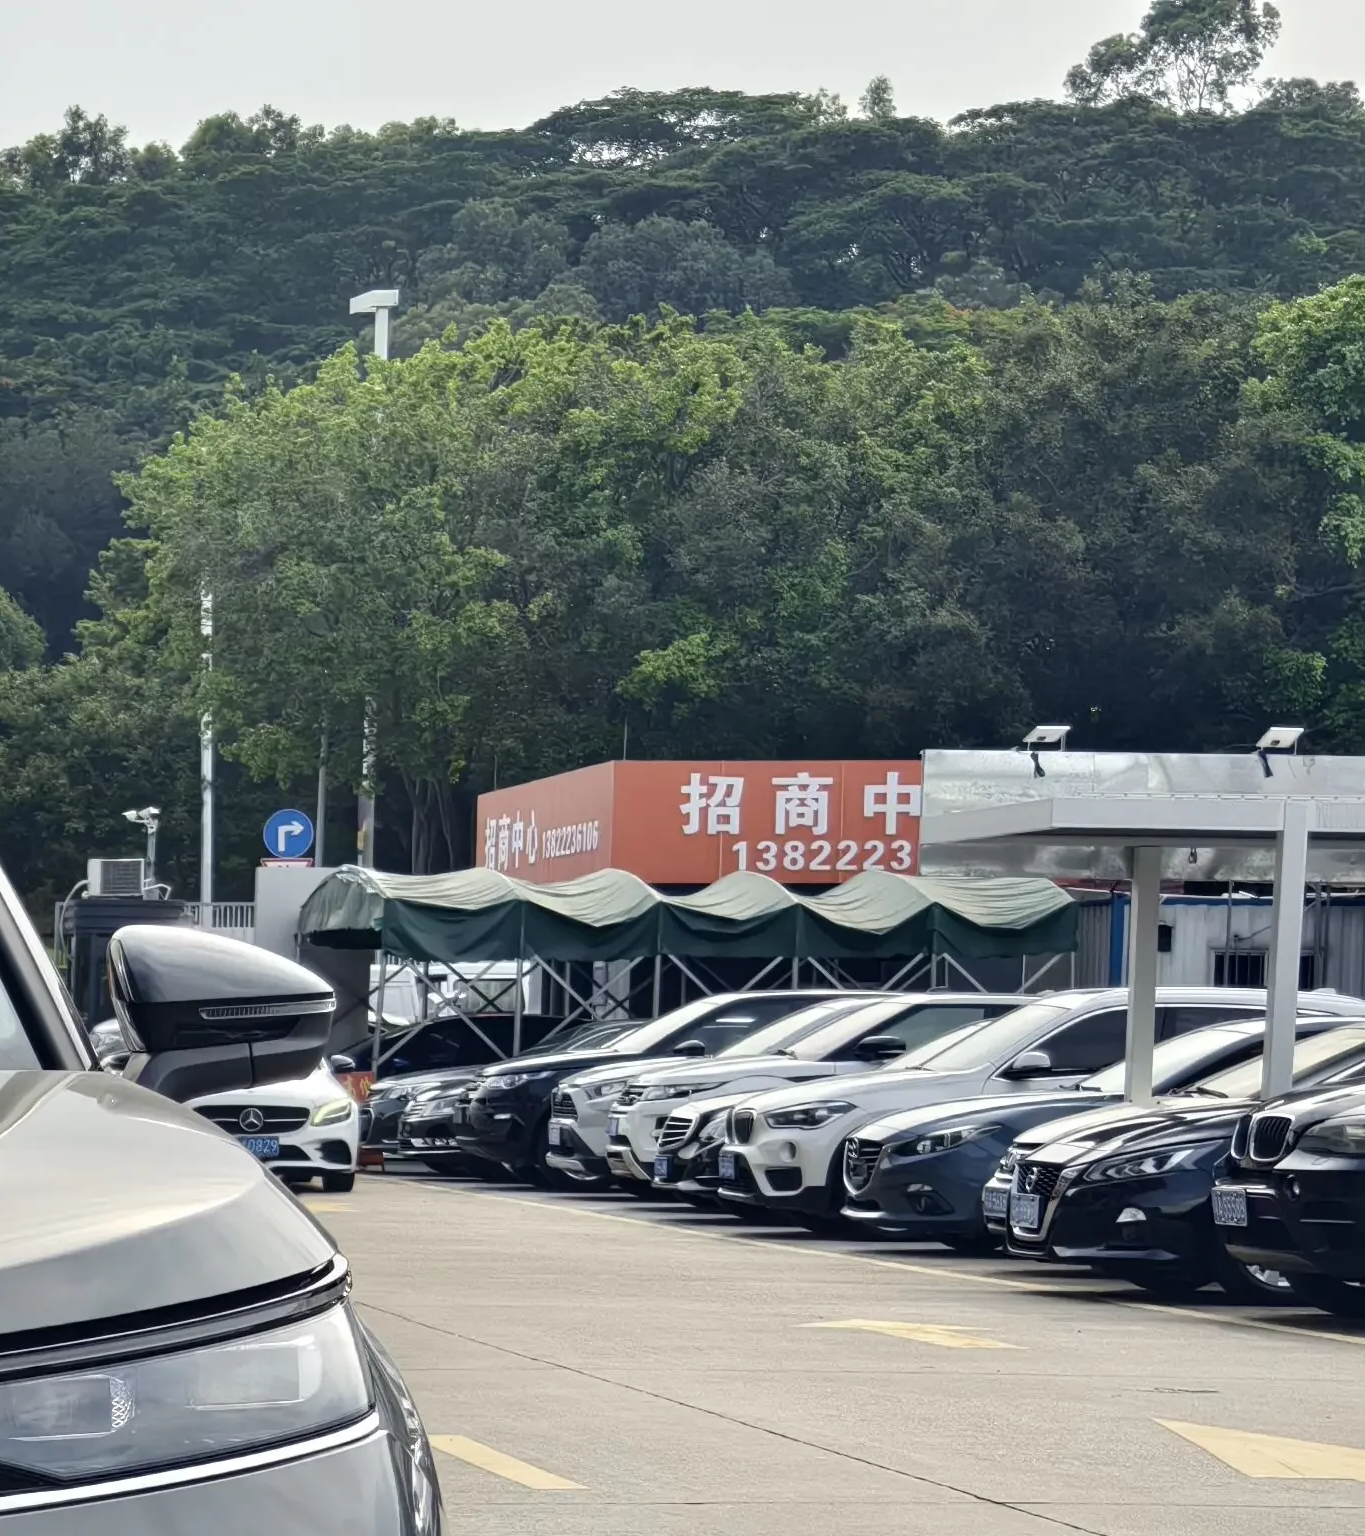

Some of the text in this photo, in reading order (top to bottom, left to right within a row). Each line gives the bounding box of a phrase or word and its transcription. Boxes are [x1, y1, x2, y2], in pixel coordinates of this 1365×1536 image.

[679, 772, 922, 836] 招商中
[485, 809, 599, 872] 招商中心 13822236106
[732, 840, 913, 872] 1382223
